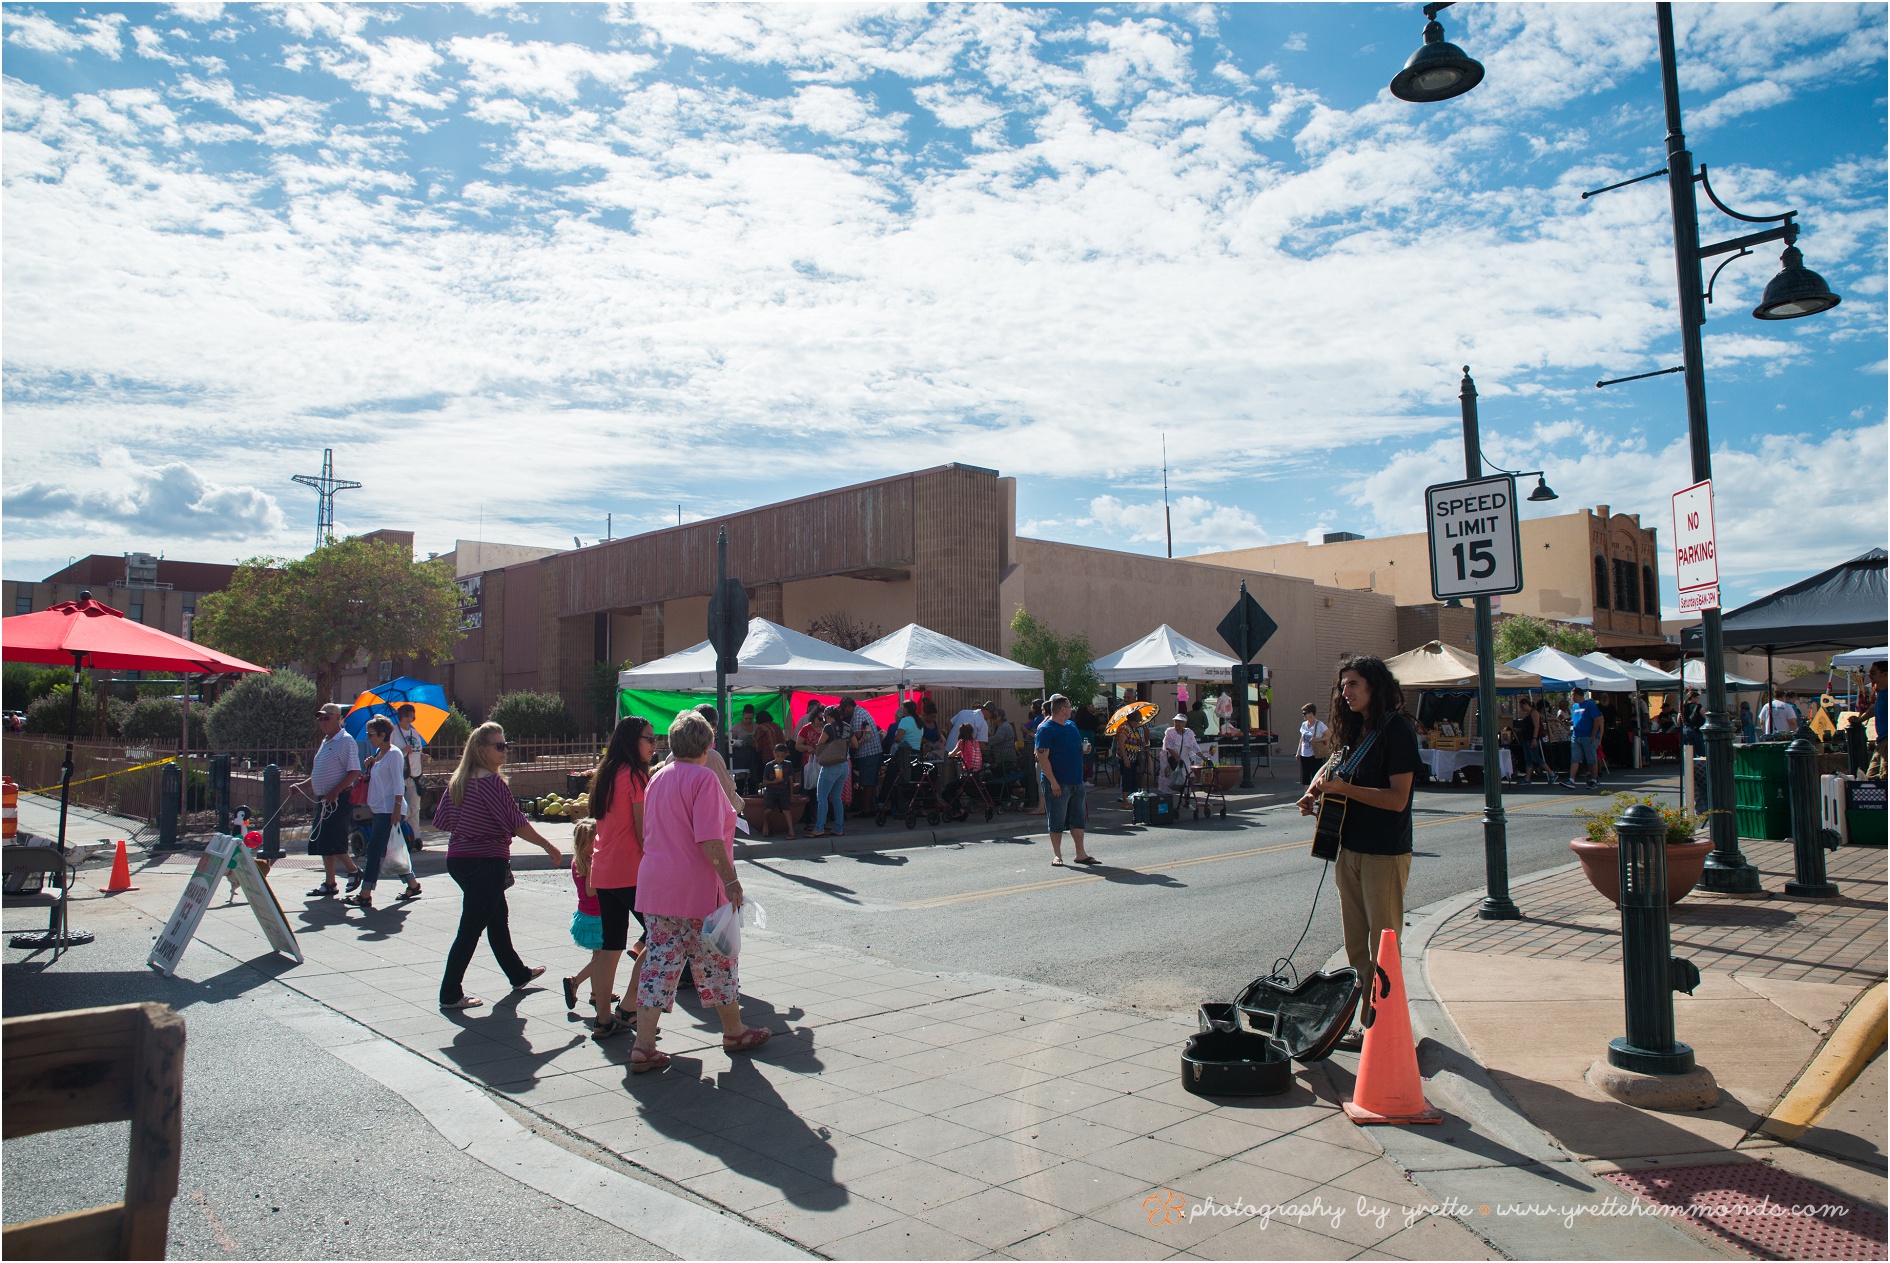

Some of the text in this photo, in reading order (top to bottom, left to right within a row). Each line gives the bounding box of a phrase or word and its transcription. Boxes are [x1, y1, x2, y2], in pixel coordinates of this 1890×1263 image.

[1436, 492, 1507, 517] SPEED
[1445, 515, 1499, 538] LIMIT
[1687, 511, 1700, 532] NO
[1452, 538, 1497, 581] 15
[1678, 540, 1714, 566] PARKING
[184, 881, 207, 904] SHAVED
[179, 901, 194, 920] ICE
[152, 934, 178, 962] FLAVORS
